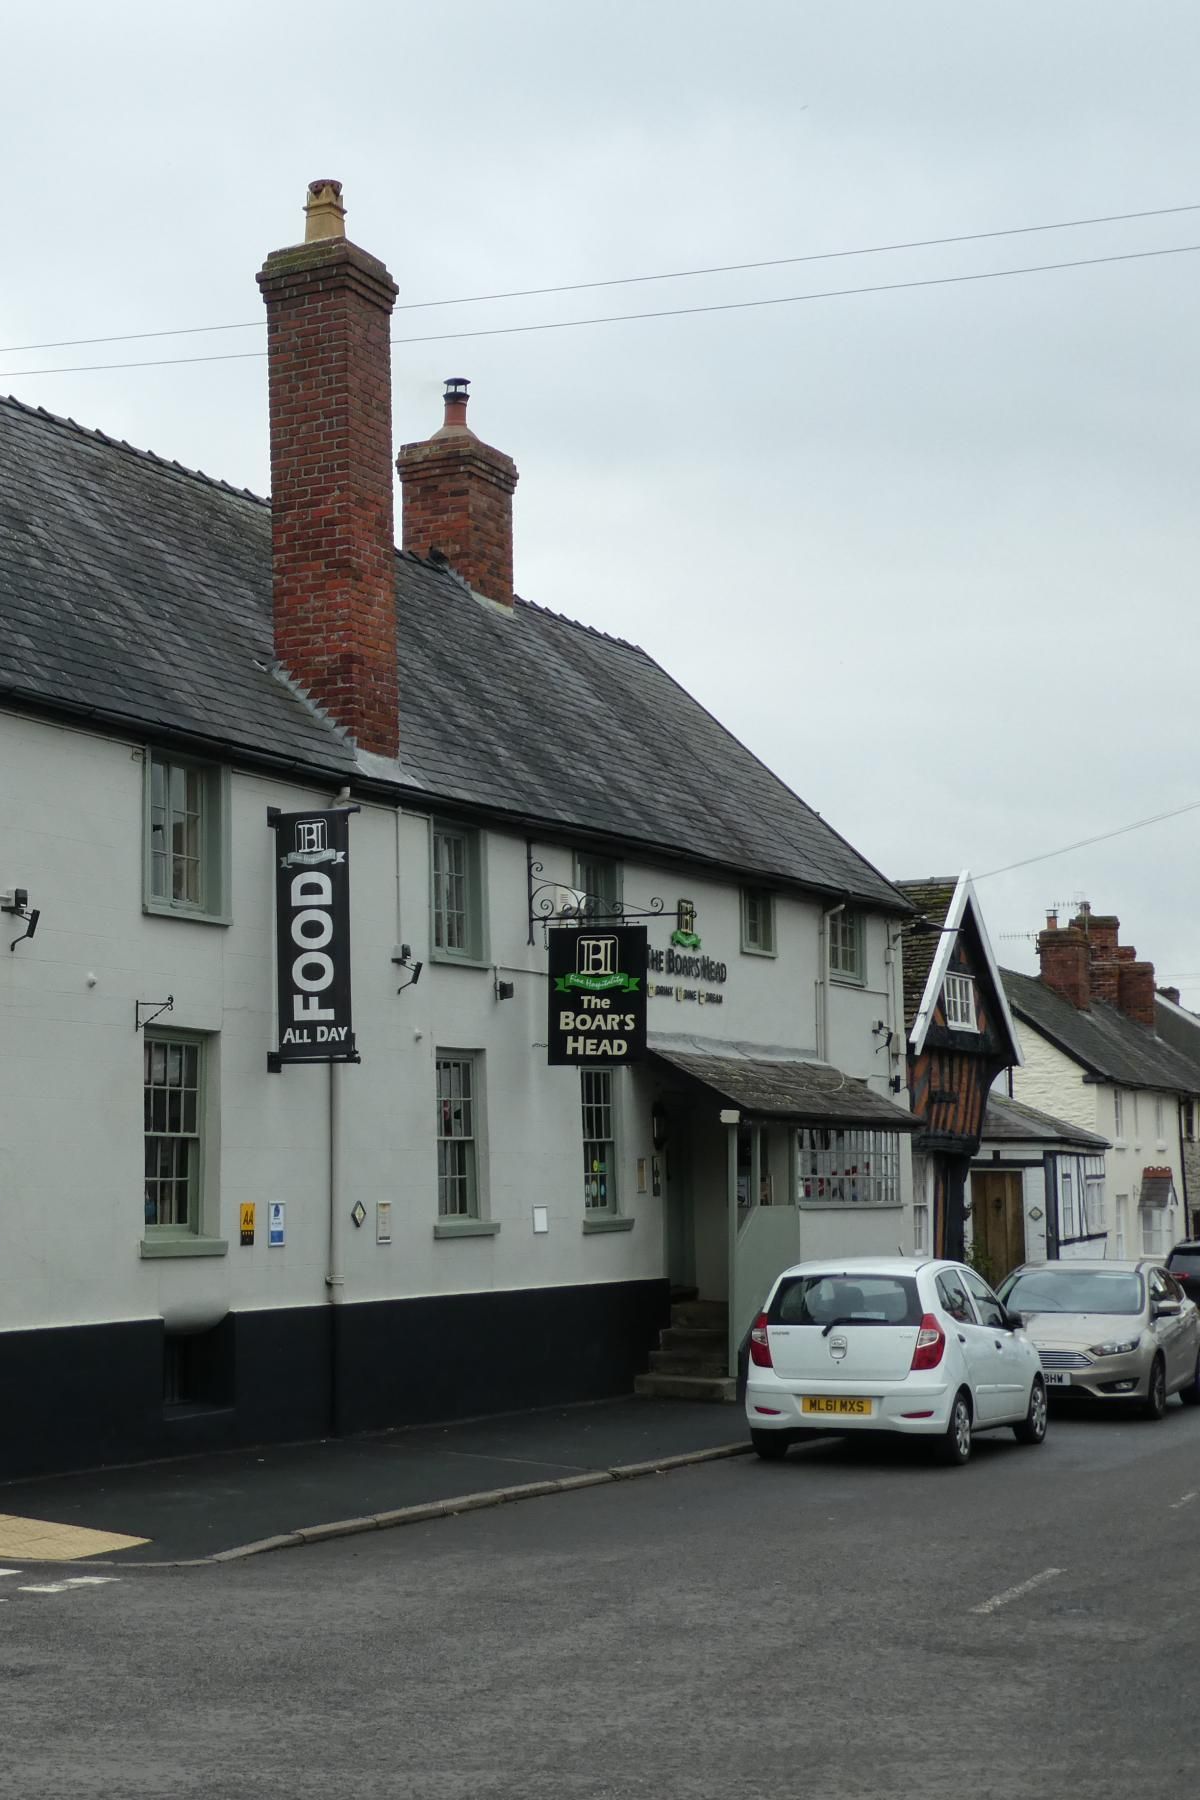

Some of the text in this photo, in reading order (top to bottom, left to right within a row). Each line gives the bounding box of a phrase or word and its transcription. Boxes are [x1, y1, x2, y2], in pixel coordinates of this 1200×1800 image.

[290, 871, 335, 1021] FOOD
[701, 955, 727, 984] HEAD
[569, 974, 624, 990] Fine Hospitality
[581, 995, 611, 1009] The
[559, 1011, 635, 1031] BOAR'S
[283, 1026, 348, 1044] ALL DAY
[566, 1035, 628, 1055] HEAD
[243, 1209, 254, 1225] AA
[809, 1399, 865, 1413] ML61 MXS
